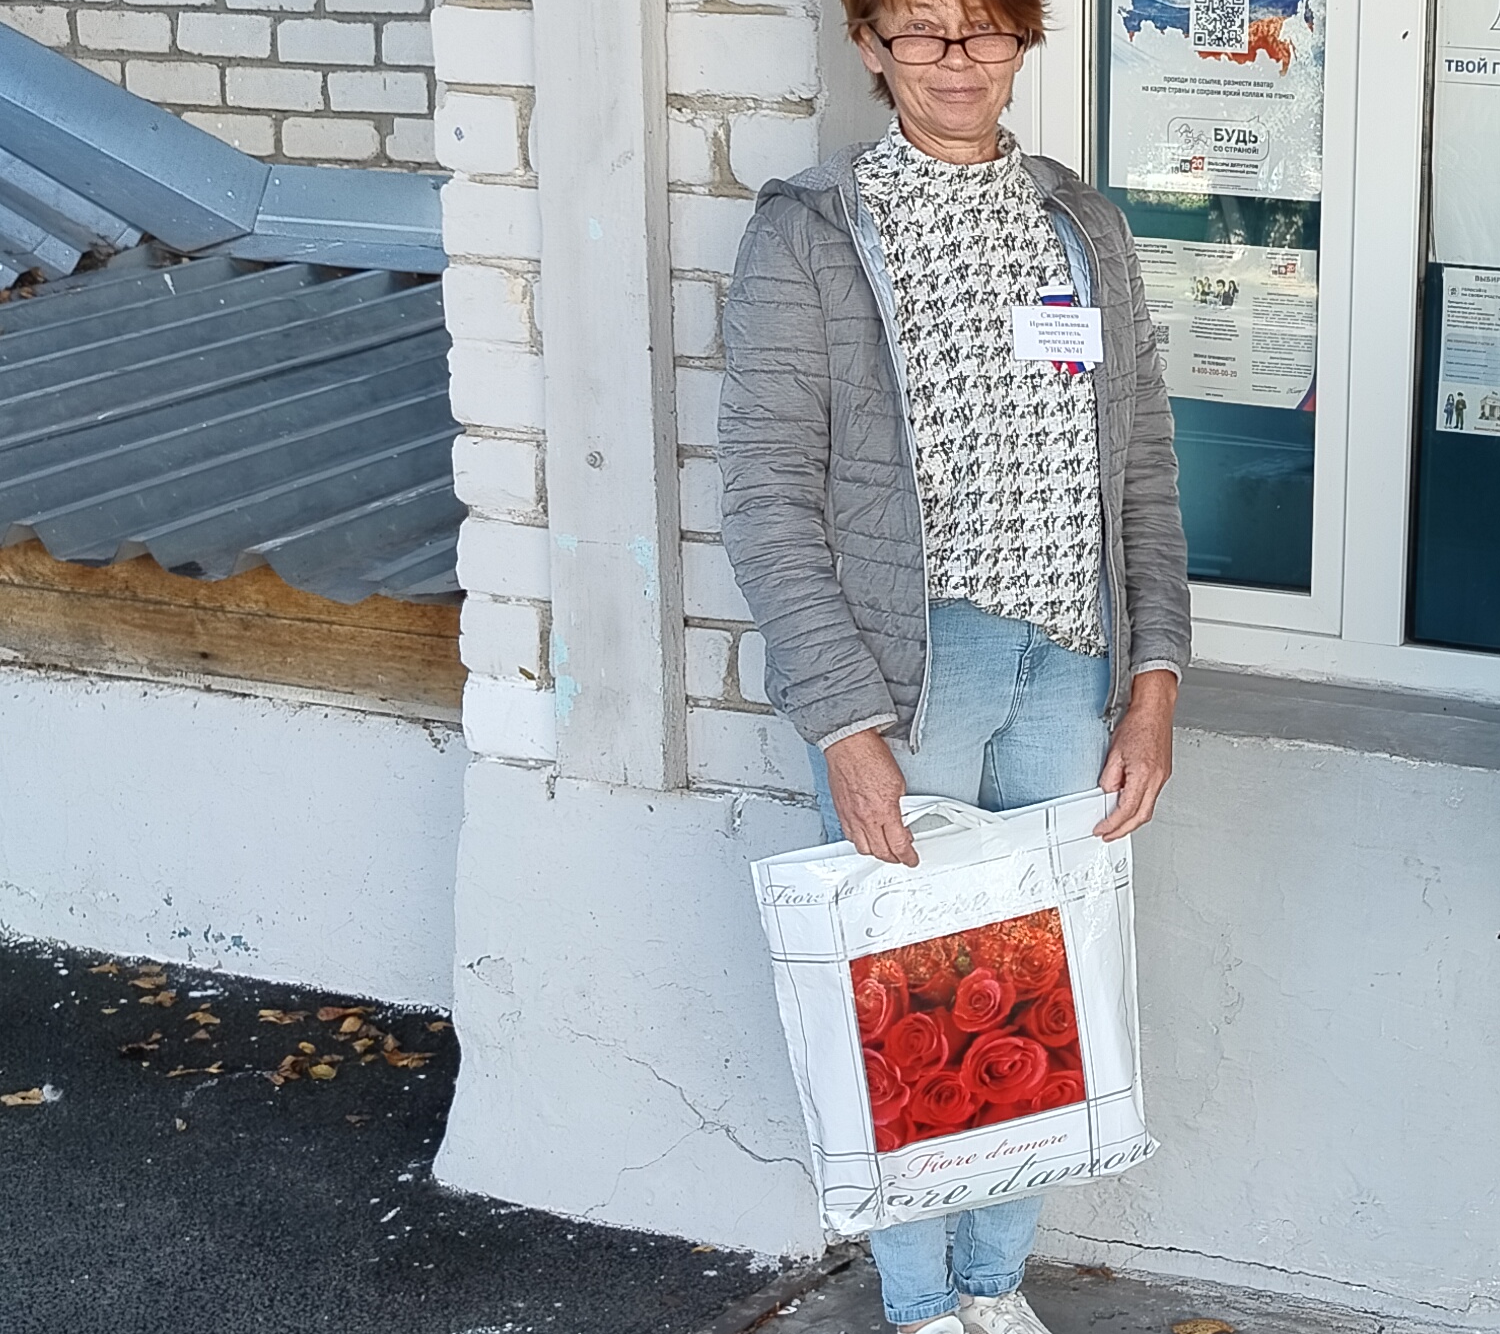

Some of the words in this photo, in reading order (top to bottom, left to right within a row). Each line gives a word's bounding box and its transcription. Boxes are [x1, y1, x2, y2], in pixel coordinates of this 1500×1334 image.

[1445, 59, 1487, 74] ТВОЙ
[1214, 128, 1258, 146] БУДЬ
[1225, 146, 1259, 154] СТРАНОЙ!
[1182, 162, 1190, 171] 19
[1192, 159, 1202, 168] 20
[902, 1151, 978, 1179] Fiore
[985, 1133, 1068, 1160] d'amore
[988, 1139, 1155, 1196] d'amore
